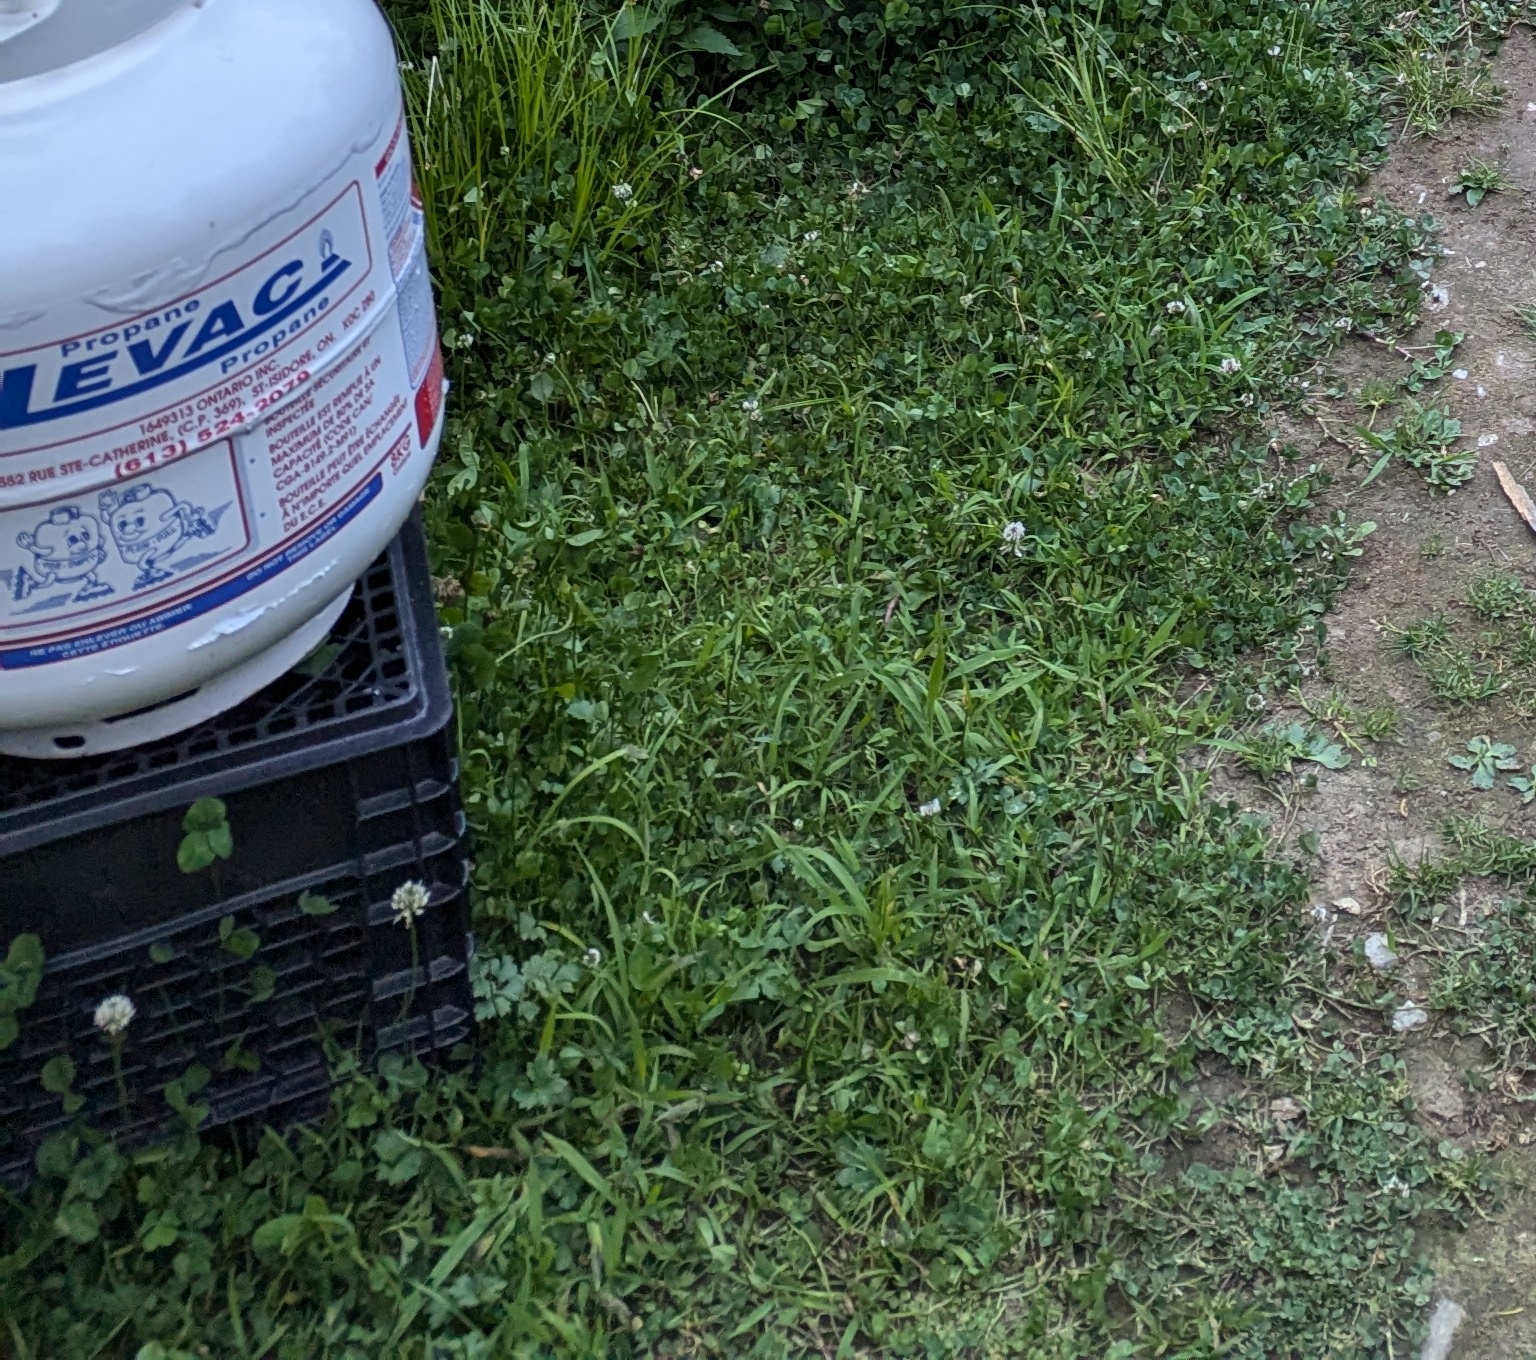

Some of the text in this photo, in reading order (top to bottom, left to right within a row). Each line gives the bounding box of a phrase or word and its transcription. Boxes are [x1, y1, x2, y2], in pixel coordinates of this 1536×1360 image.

[0, 259, 345, 429] LEVAC
[61, 298, 200, 359] Propane
[220, 296, 330, 375] Propane
[138, 358, 281, 436] 1649313 ONTARIO INC.
[113, 439, 188, 480] (613)
[269, 416, 316, 454] BOUTEILLE
[271, 425, 321, 466] MAXIMUM
[323, 414, 334, 430] DE
[28, 466, 56, 483] RUE
[279, 468, 325, 508] BOUTEILLE
[327, 451, 346, 474] PEUT
[283, 516, 298, 532] DU
